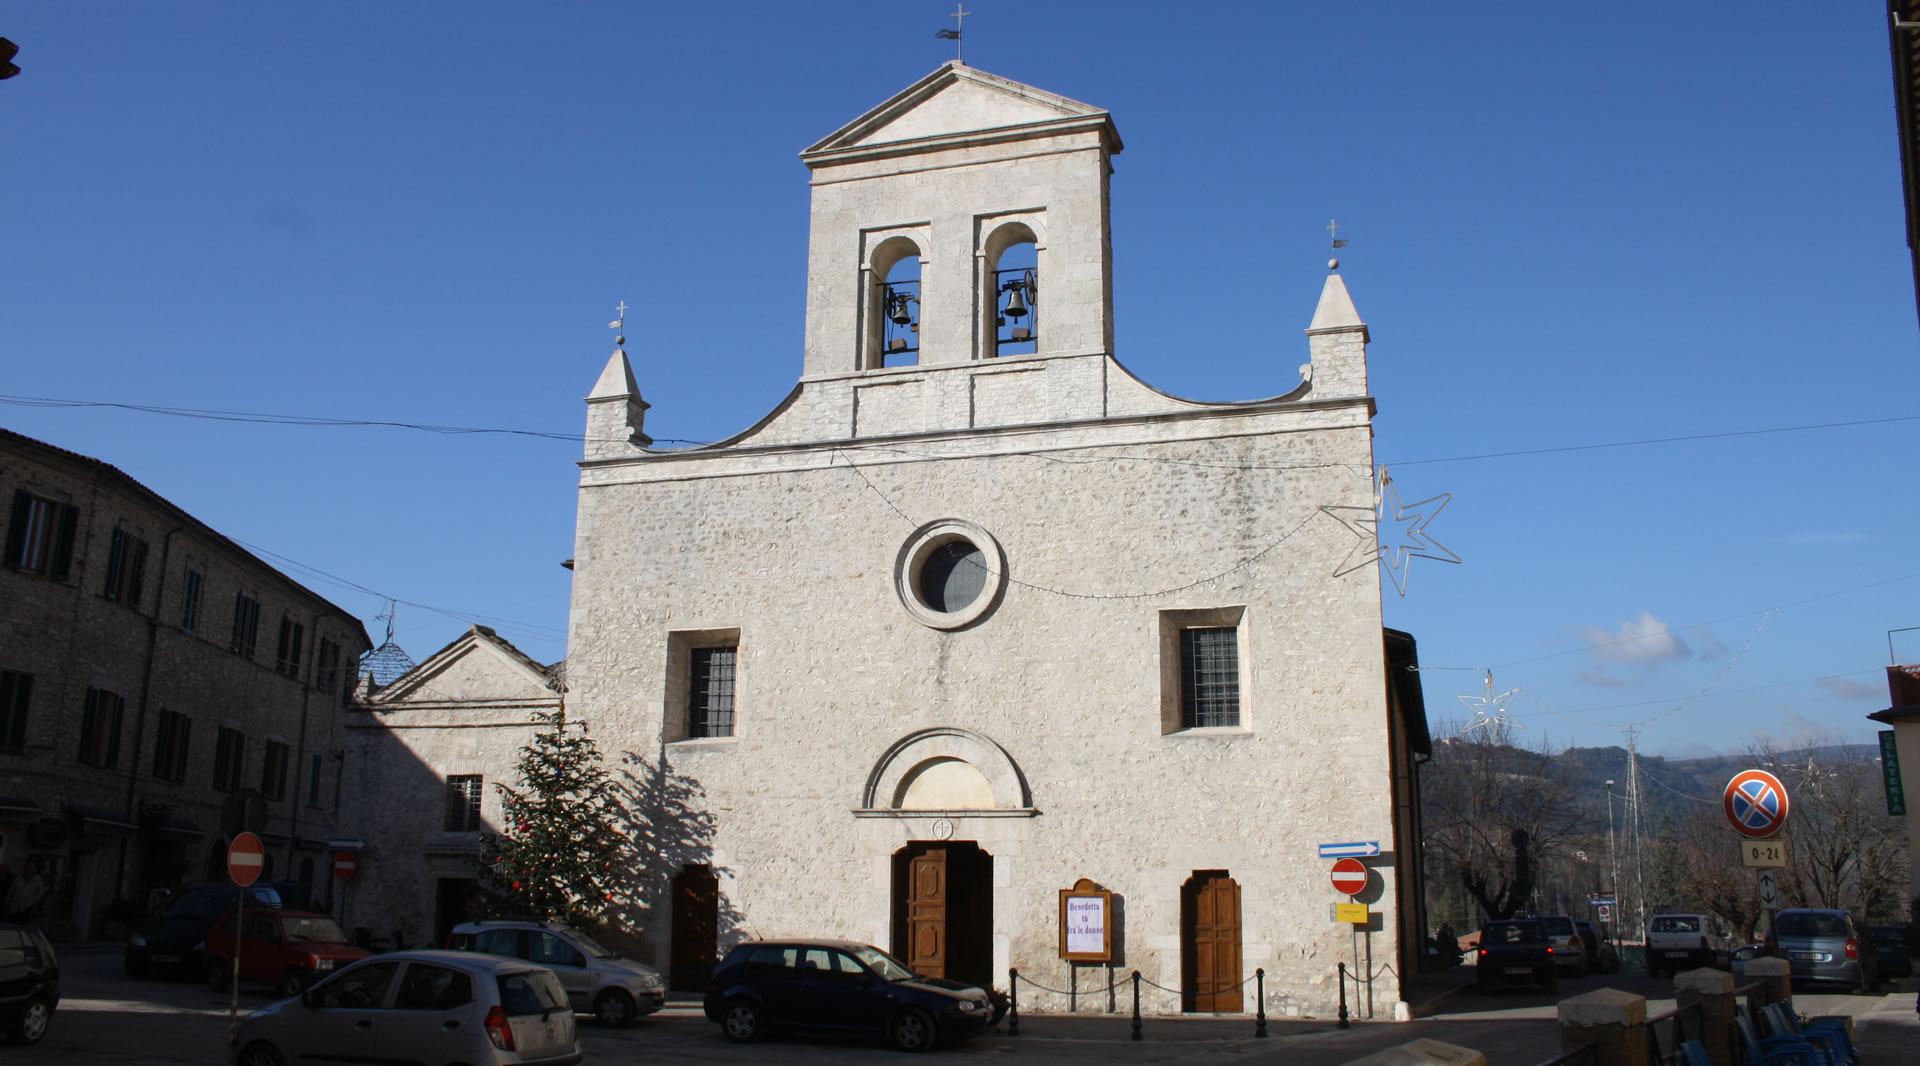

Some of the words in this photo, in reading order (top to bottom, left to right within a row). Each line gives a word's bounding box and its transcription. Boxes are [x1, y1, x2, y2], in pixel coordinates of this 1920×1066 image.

[1883, 733, 1902, 812] GELATERIA
[1752, 847, 1779, 860] 0-24
[1069, 902, 1100, 911] Benedetta
[1078, 926, 1083, 934] le
[1085, 925, 1104, 934] donne
